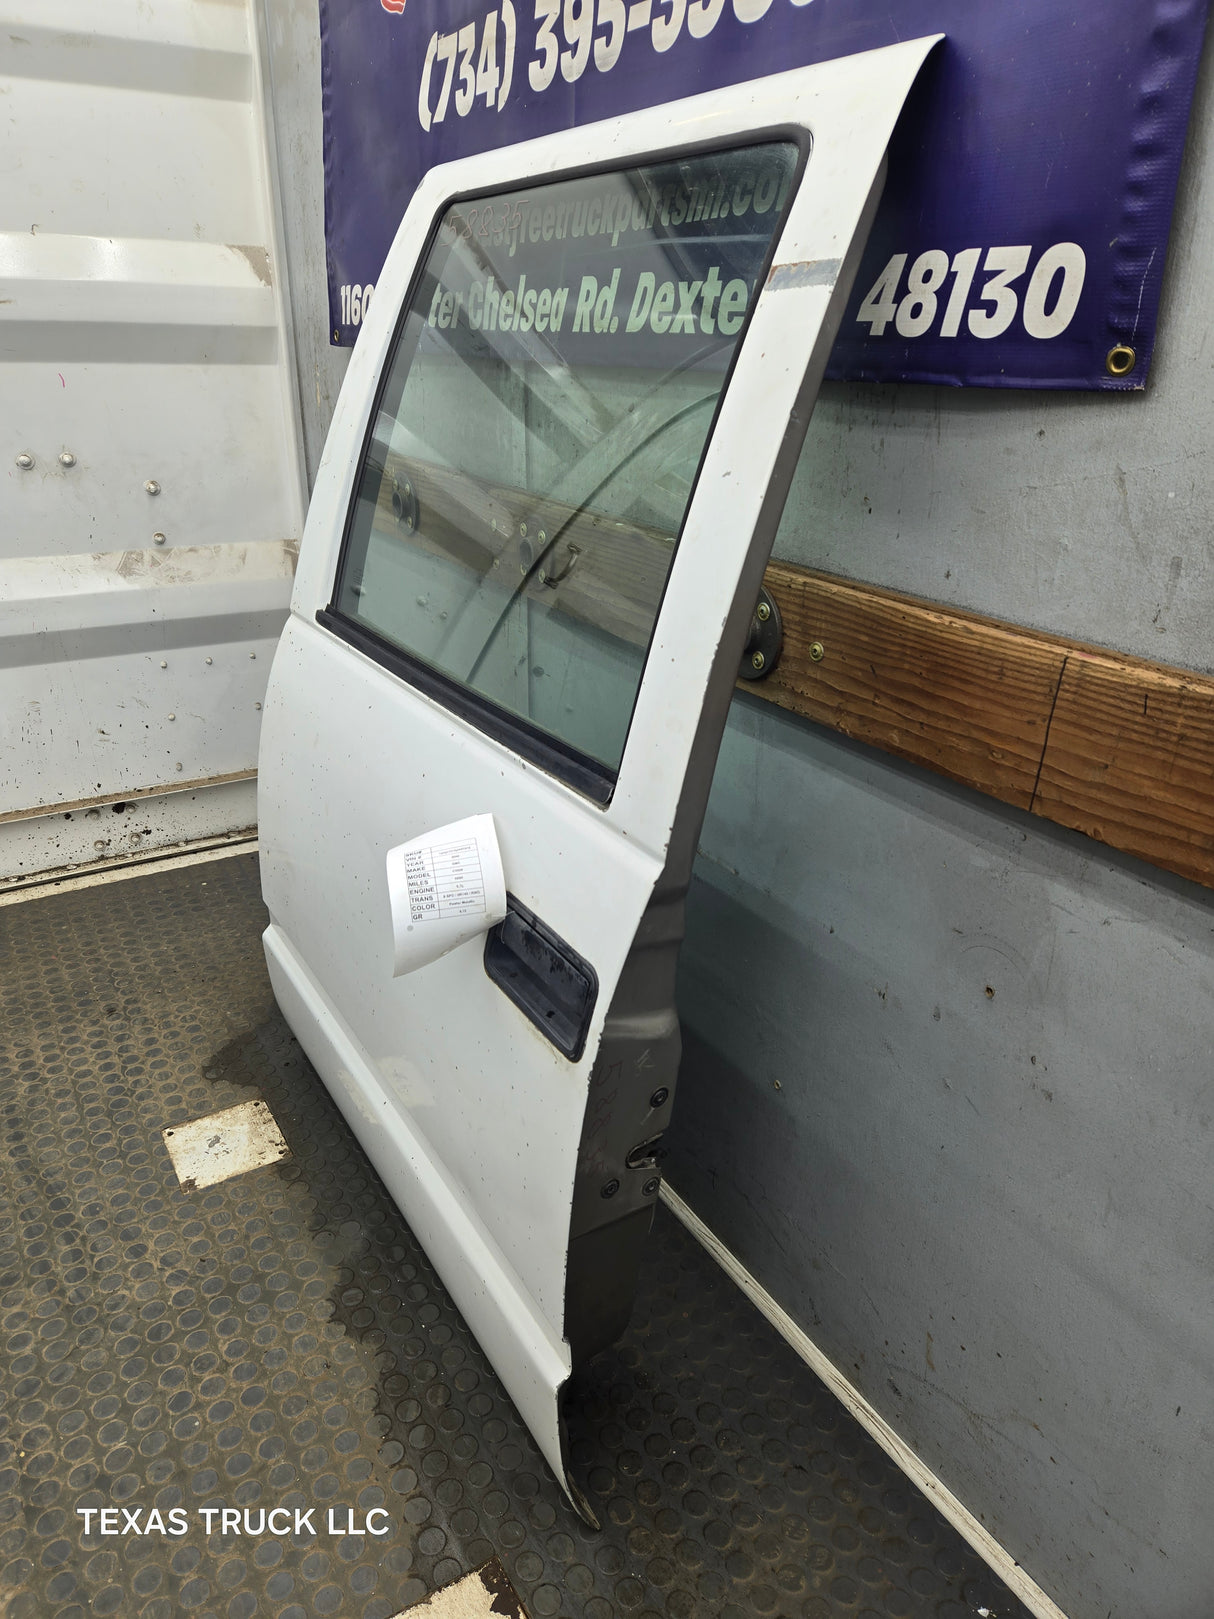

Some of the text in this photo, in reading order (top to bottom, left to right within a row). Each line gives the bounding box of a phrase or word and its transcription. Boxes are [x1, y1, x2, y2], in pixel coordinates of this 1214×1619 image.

[418, 0, 516, 132] (734)
[440, 200, 529, 246] 58835
[468, 274, 569, 332] Chelsea
[572, 268, 620, 334] Rd.
[625, 266, 758, 336] Dexte
[856, 242, 1086, 339] 48130
[407, 872, 431, 880] MODEL
[408, 879, 429, 887] MILES
[409, 886, 435, 895] ENGINE
[411, 895, 434, 903] TRANS
[411, 903, 436, 912] COLOR
[412, 913, 424, 921] GR
